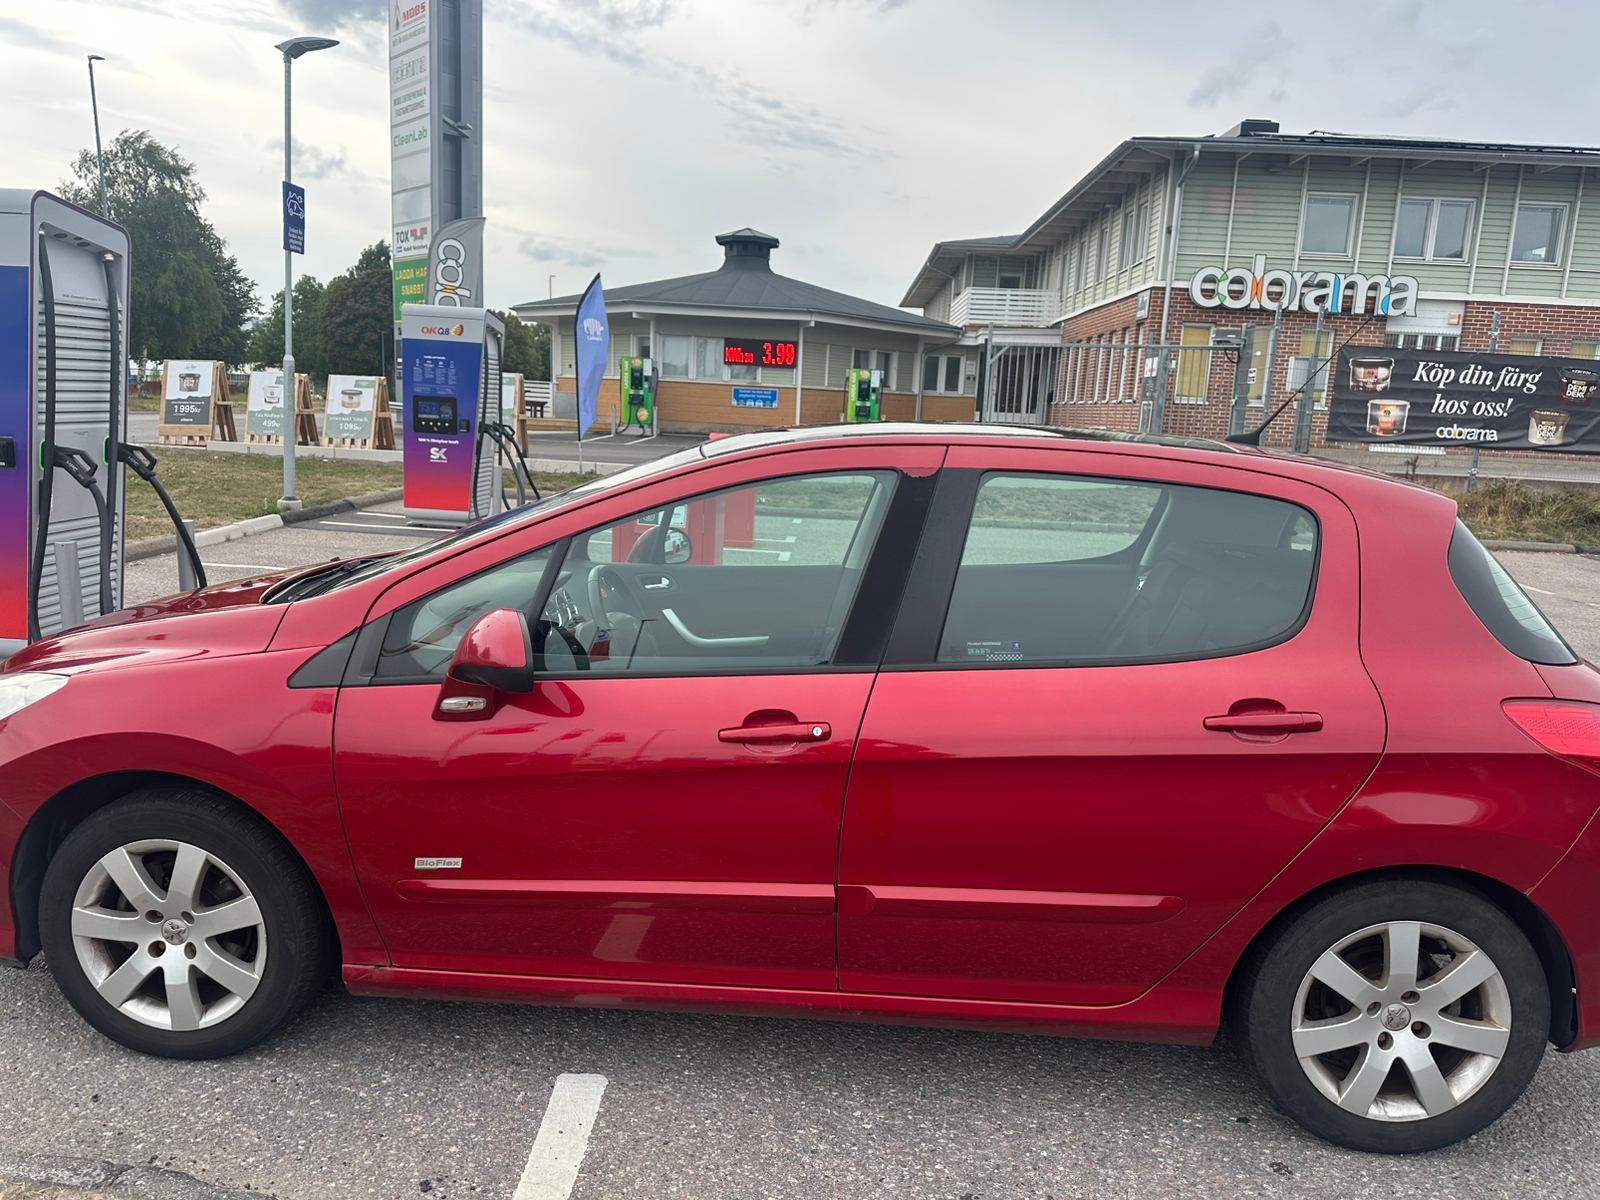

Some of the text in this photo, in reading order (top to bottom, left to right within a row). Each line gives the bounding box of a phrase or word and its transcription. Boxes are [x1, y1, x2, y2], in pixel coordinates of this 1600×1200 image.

[393, 126, 428, 147] CleanLab
[395, 230, 410, 244] TOX
[395, 268, 414, 280] LADDA
[401, 284, 424, 296] SNABBT
[1189, 254, 1419, 318] colorama
[421, 326, 450, 336] OKQ8
[762, 342, 795, 365] 3.99
[1412, 361, 1543, 394] Köp din färg
[1567, 383, 1588, 392] DEMI
[1431, 393, 1514, 417] hos oss!
[1436, 424, 1498, 441] colorama
[416, 859, 460, 867] BioFlex
